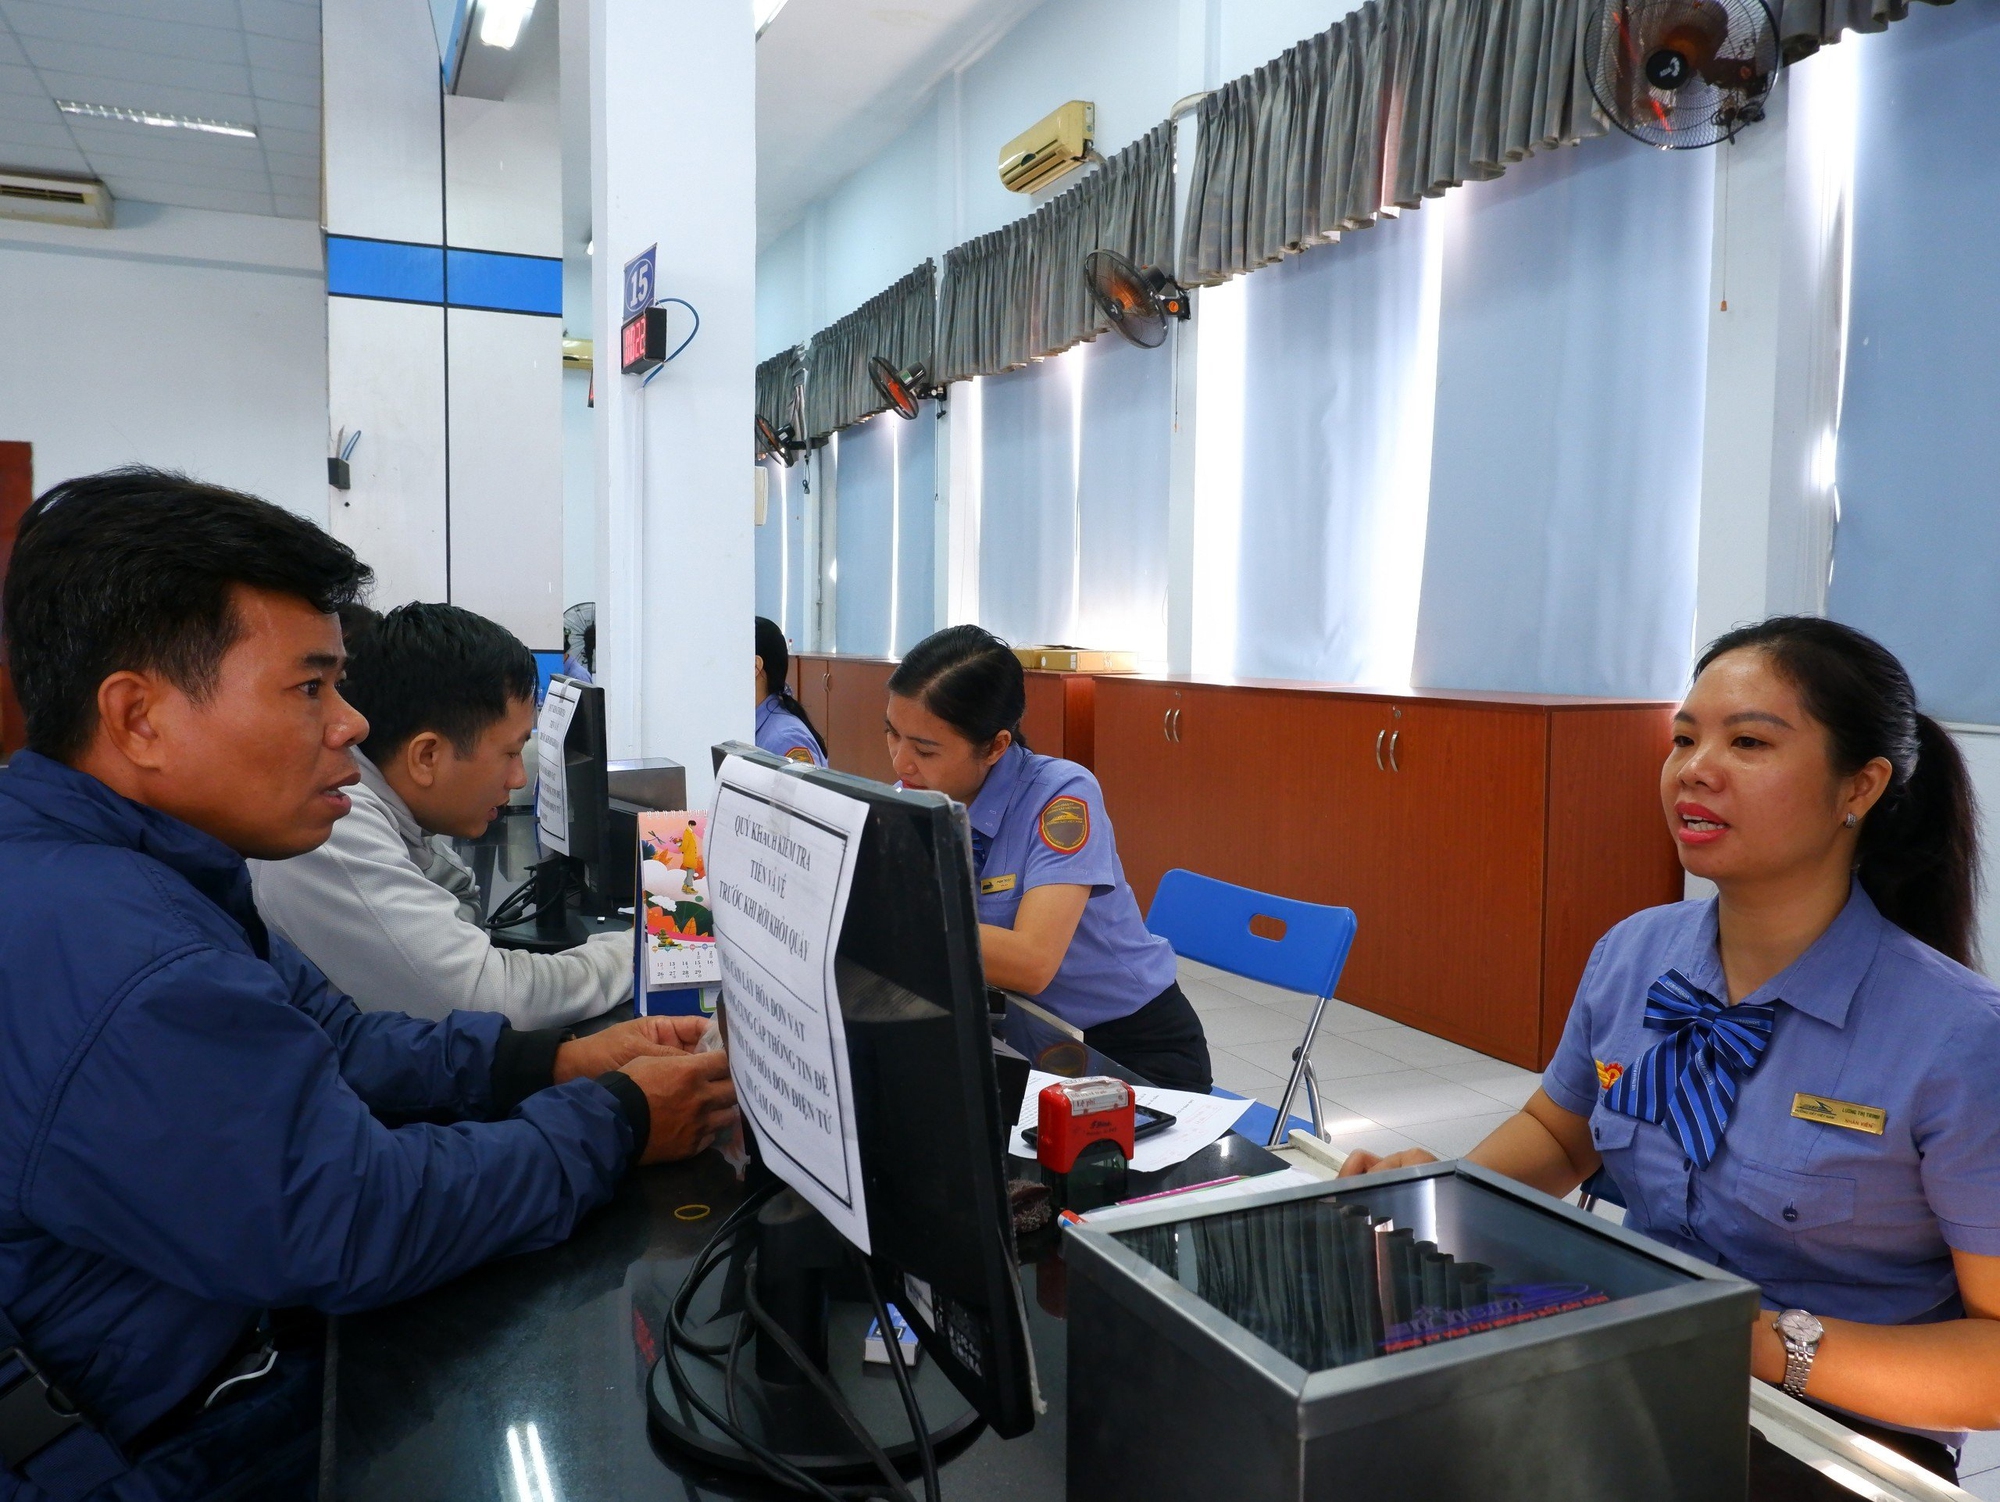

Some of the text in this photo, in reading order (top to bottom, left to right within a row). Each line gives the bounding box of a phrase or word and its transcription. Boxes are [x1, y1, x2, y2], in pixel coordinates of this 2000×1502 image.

[630, 264, 649, 307] 15
[735, 814, 751, 837] QUÝ
[796, 844, 811, 871] TRA
[719, 880, 743, 910] TRƯỚC
[743, 895, 757, 920] KHI
[768, 915, 789, 945] KHỎI
[787, 1012, 805, 1042] VAT
[796, 1055, 813, 1084] TIN
[791, 1087, 815, 1121] ĐIỆN
